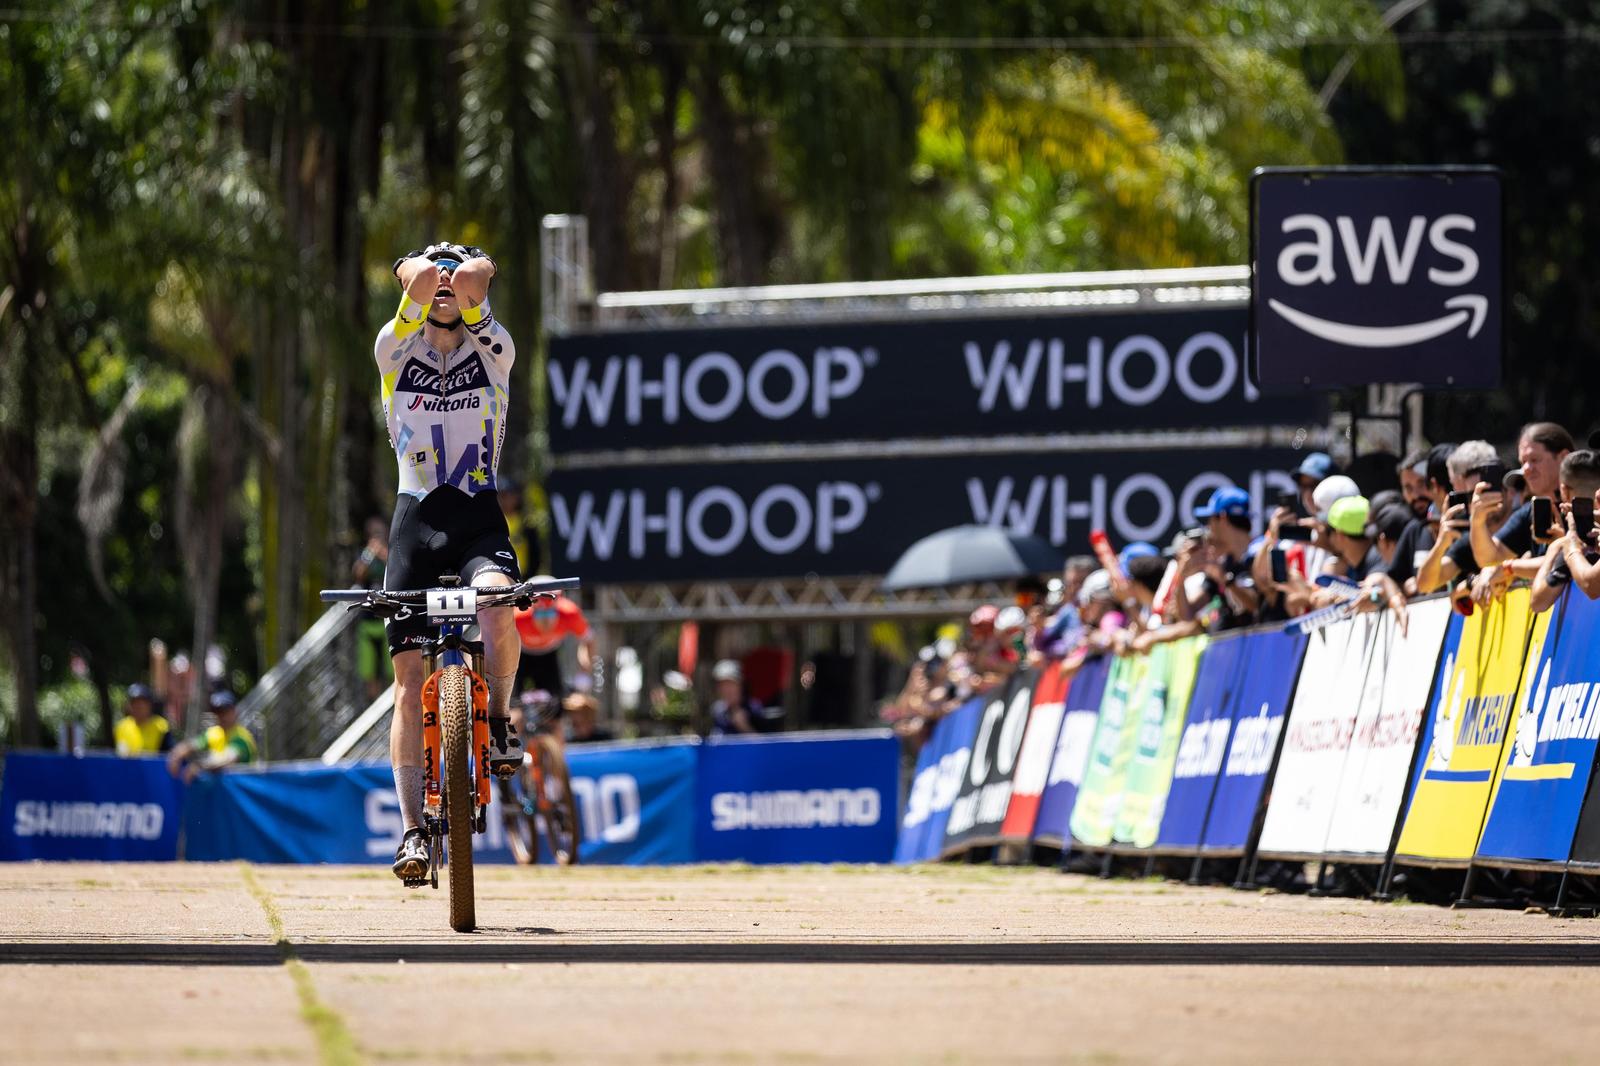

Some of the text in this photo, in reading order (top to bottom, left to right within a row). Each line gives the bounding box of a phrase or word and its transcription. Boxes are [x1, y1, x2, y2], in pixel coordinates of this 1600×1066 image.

[1277, 214, 1480, 287] aws
[547, 346, 865, 429] WHOOP
[963, 331, 1259, 412] WHOO
[423, 392, 480, 412] vittoria
[550, 480, 868, 562] WHOOP
[437, 595, 464, 610] 11
[13, 801, 164, 841] SHIMANO
[711, 787, 881, 832] SHIMANO
